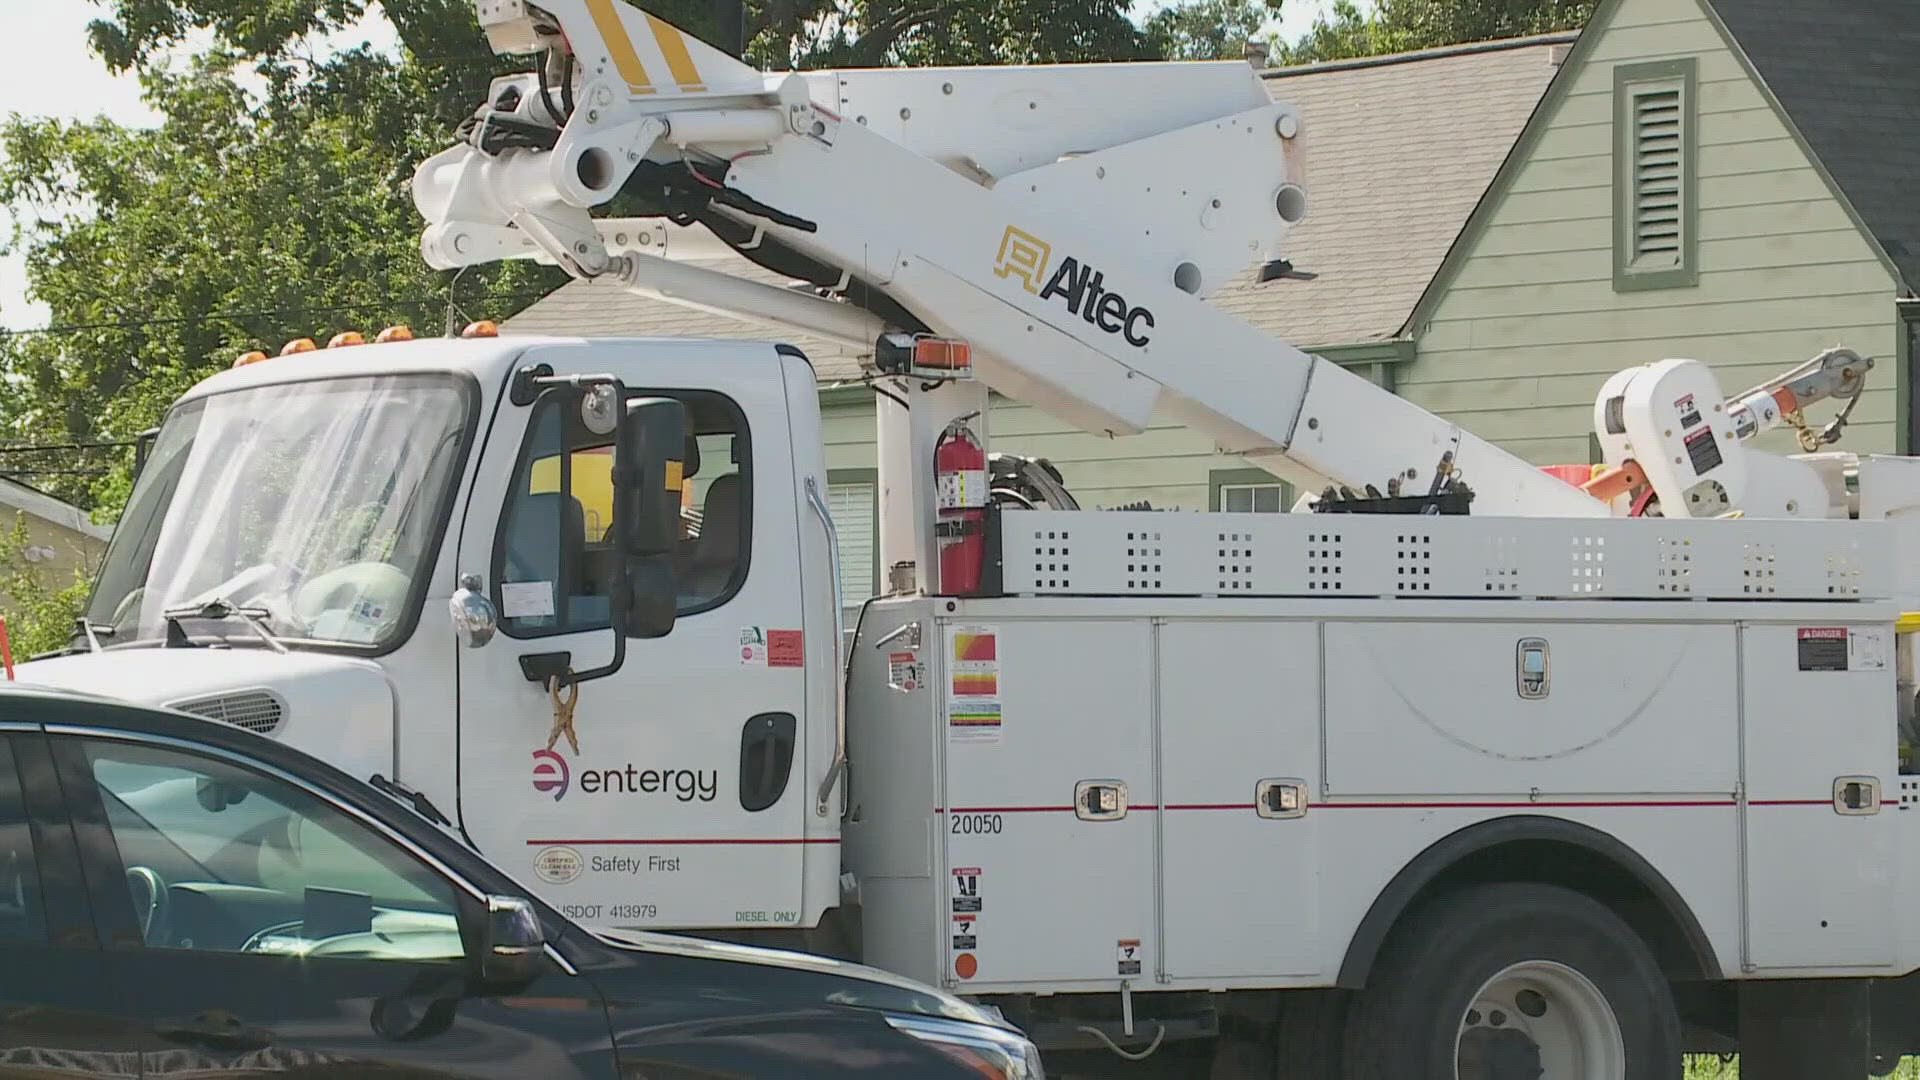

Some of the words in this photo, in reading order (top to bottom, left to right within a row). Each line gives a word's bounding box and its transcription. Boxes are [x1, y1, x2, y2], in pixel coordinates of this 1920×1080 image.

[1039, 255, 1155, 347] Altec
[1811, 629, 1842, 638] DANGER
[580, 763, 717, 802] entergy
[951, 814, 1002, 834] 20050
[591, 855, 641, 875] Safety
[648, 855, 681, 872] First
[609, 904, 657, 919] 413979
[735, 911, 768, 922] DIESEL
[773, 911, 797, 922] ONLY
